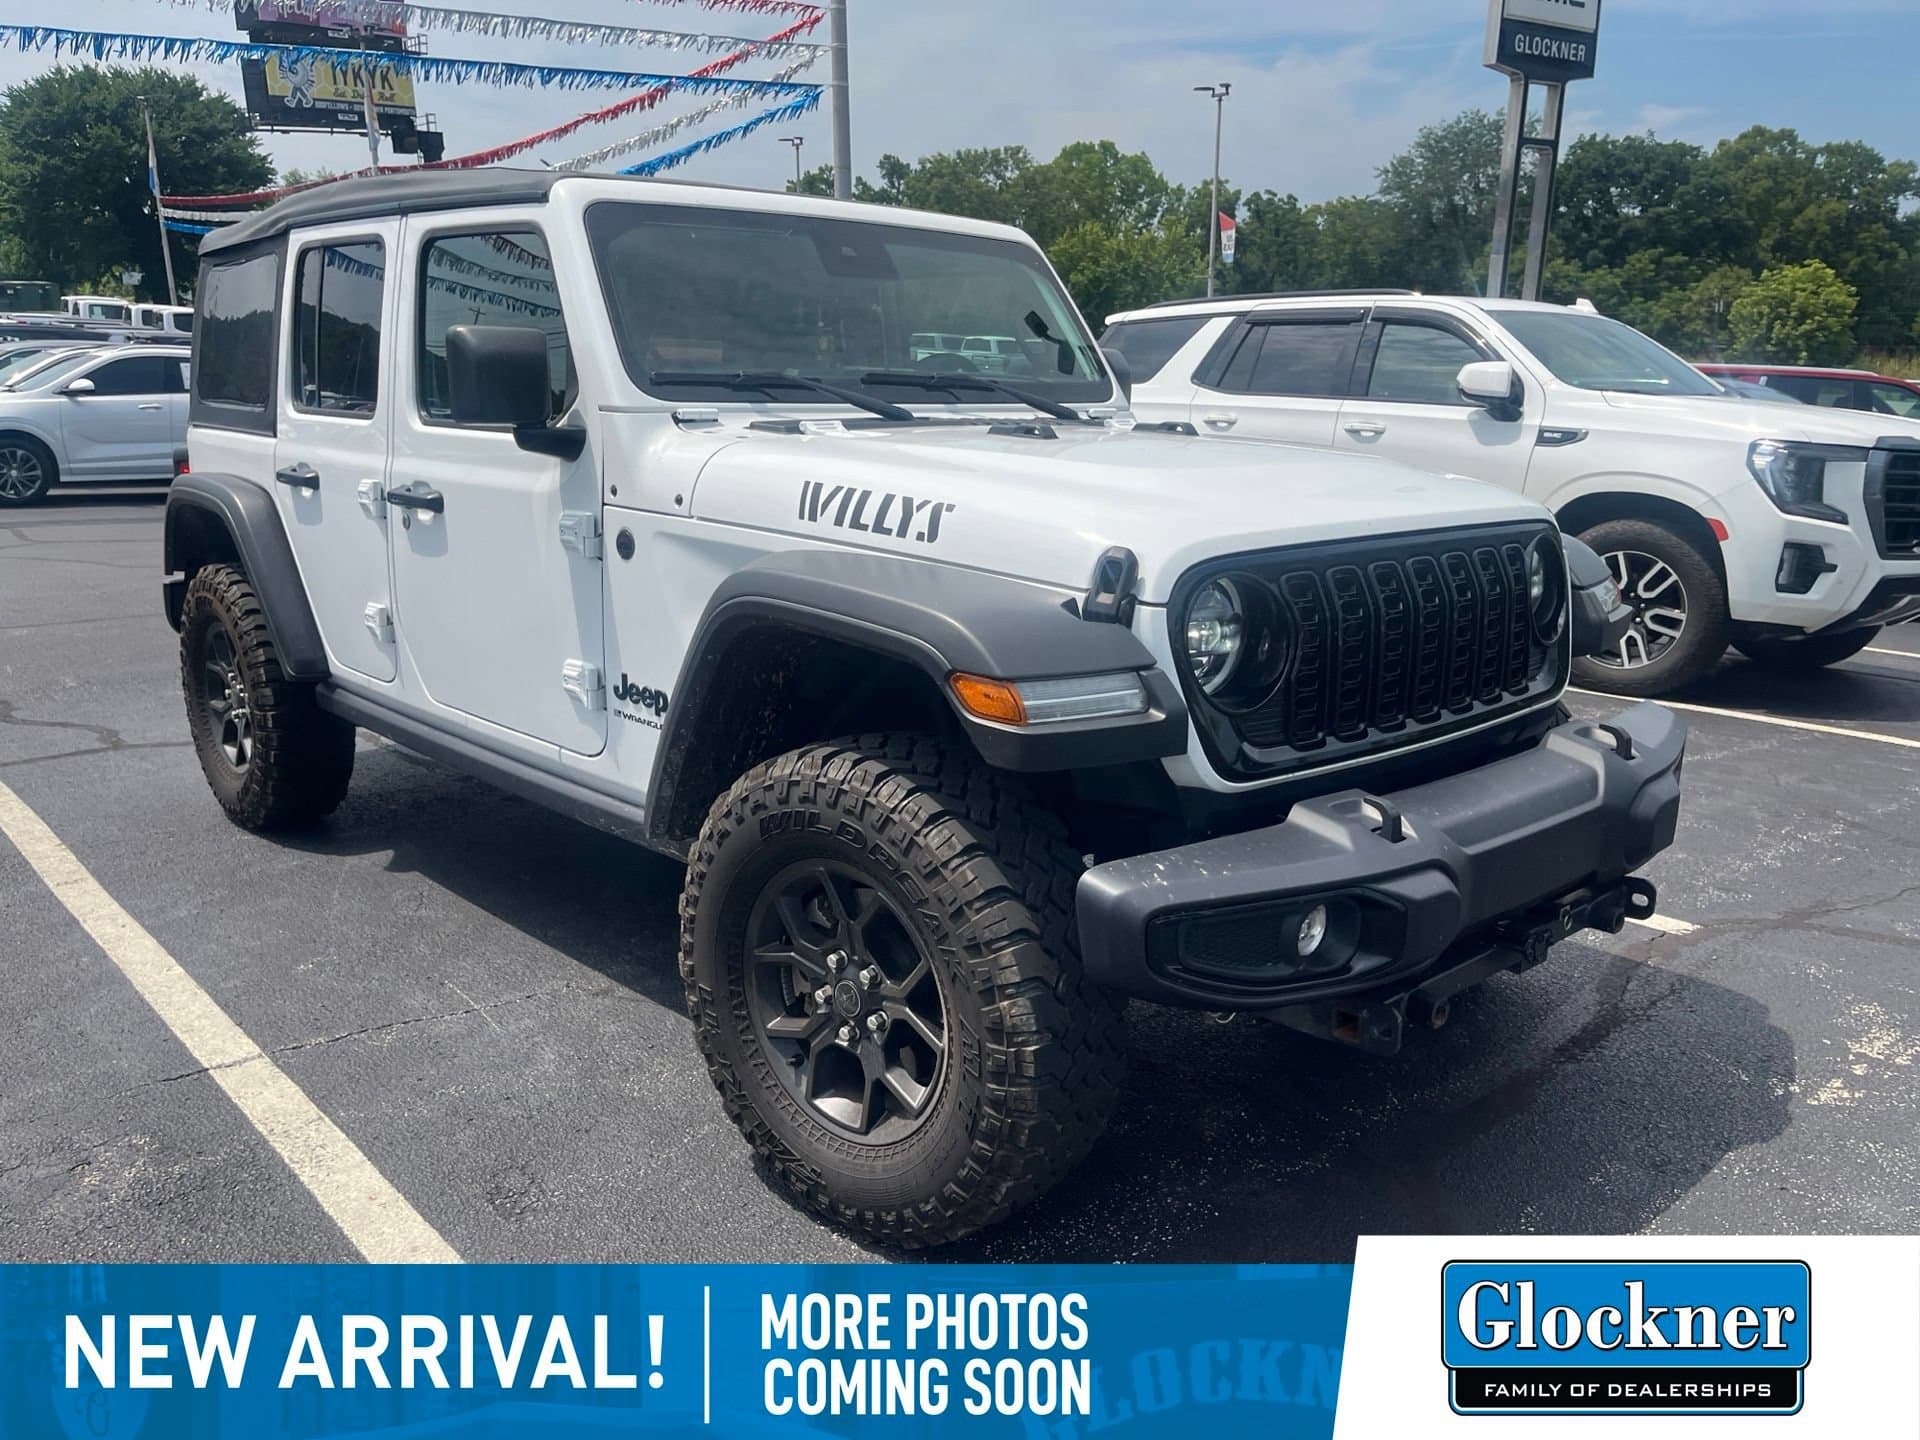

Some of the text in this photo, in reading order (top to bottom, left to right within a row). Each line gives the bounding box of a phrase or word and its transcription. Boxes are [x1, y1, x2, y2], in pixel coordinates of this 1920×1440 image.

[1514, 33, 1586, 63] GLOCKNER
[798, 480, 957, 544] WILLYS
[613, 672, 669, 717] Jeep
